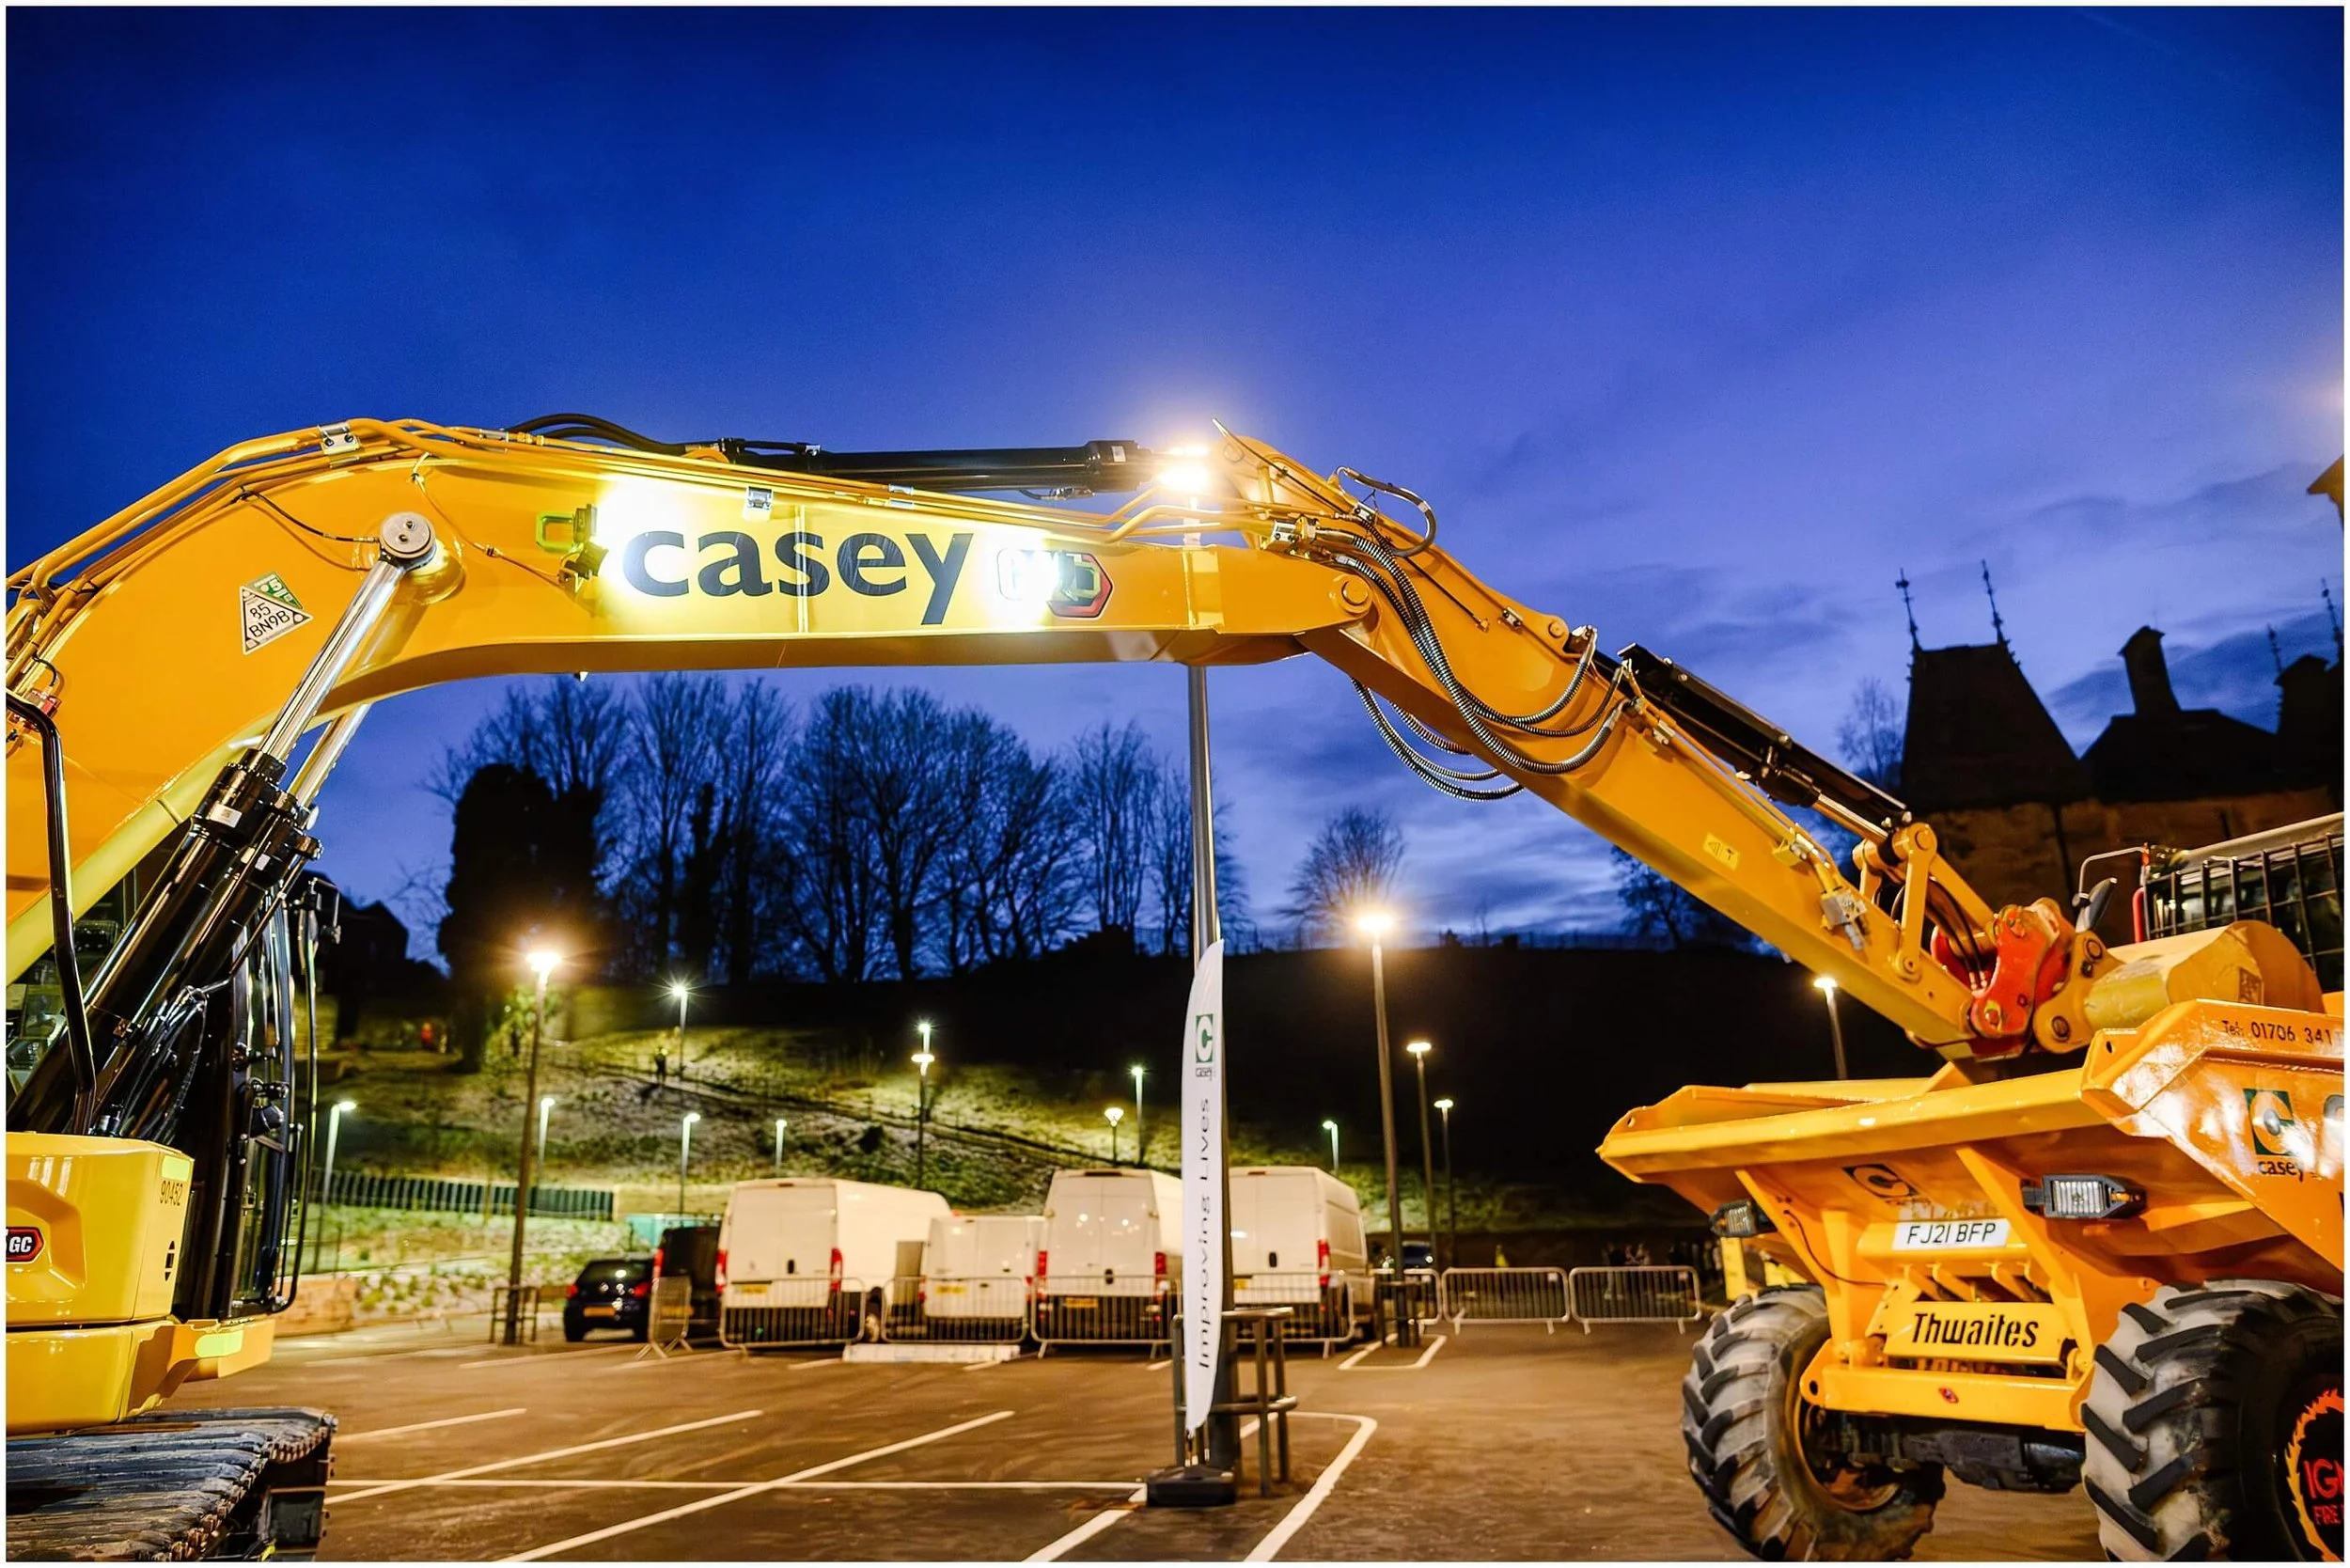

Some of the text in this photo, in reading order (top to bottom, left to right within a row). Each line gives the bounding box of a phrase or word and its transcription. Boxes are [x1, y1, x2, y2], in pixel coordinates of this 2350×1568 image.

[623, 529, 974, 625] casey
[250, 603, 271, 619] 85
[249, 610, 290, 637] BN9B
[2251, 1022, 2295, 1042] 01706
[2258, 1161, 2304, 1183] casey
[160, 1180, 183, 1206] 90452
[9, 1236, 32, 1253] GC
[1198, 1098, 1211, 1368] Improving Lives
[1906, 1222, 1997, 1245] FJ21 BFP
[1912, 1313, 2039, 1347] Thwaites
